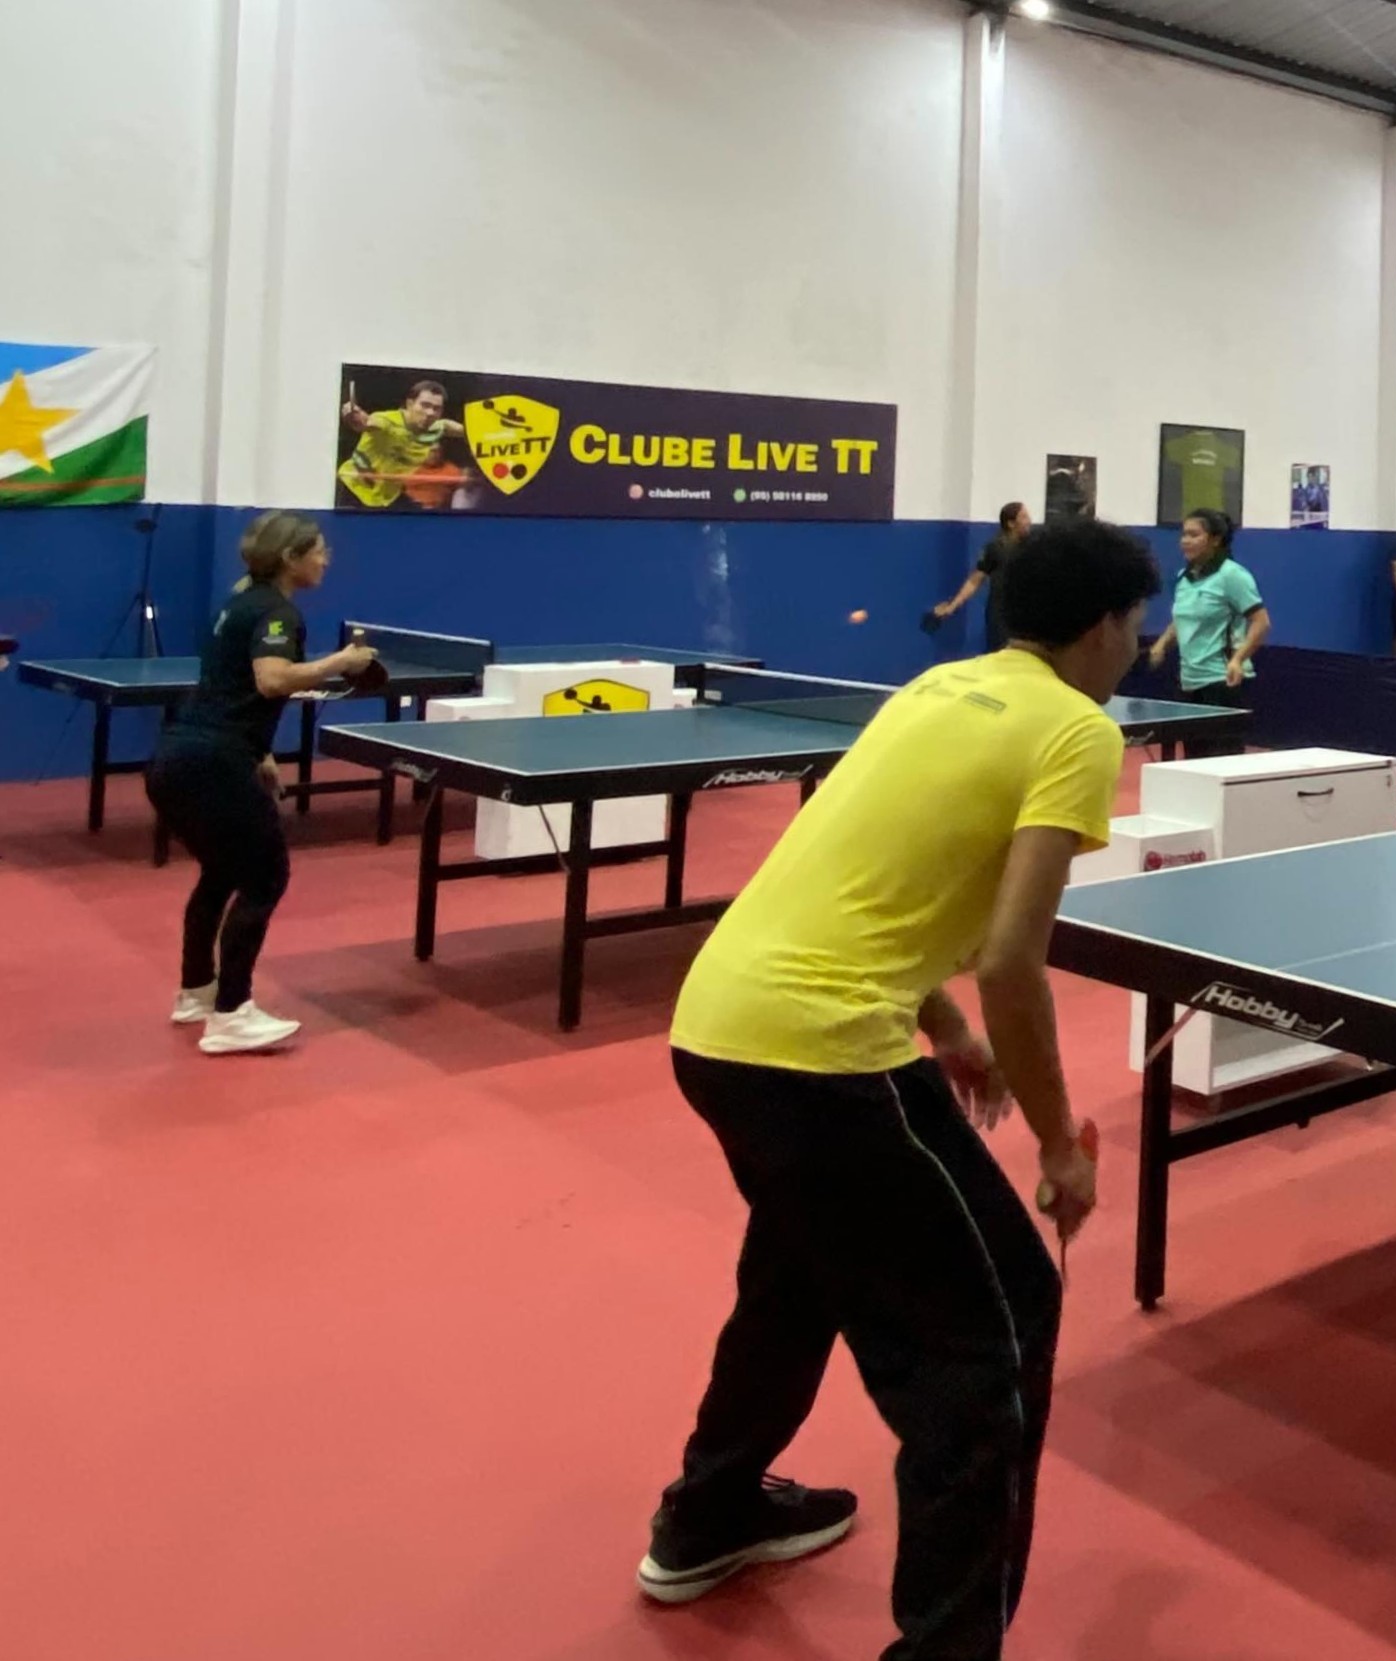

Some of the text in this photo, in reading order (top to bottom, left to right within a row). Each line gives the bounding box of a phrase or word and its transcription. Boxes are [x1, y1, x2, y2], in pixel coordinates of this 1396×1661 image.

[568, 424, 879, 474] CLUBE LIVE TT
[1204, 985, 1300, 1030] Hobby
